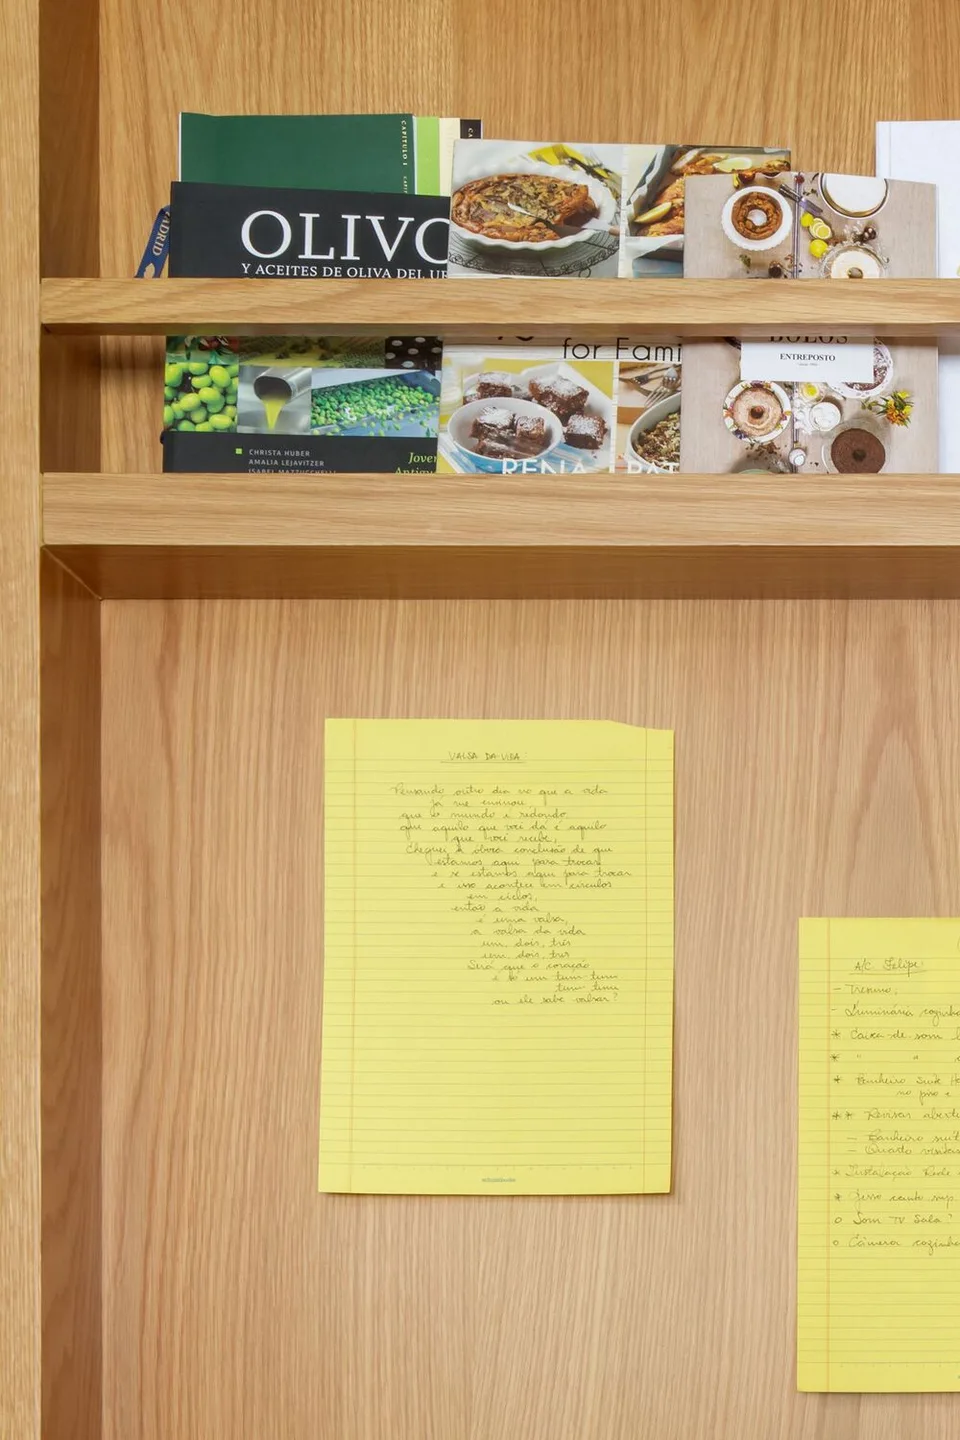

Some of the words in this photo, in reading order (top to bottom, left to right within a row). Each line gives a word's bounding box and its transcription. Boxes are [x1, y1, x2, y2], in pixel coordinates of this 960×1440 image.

[241, 263, 251, 274] Y
[255, 264, 317, 278] ACEITES
[322, 266, 343, 278] DE
[347, 267, 392, 279] OLIVA
[563, 337, 601, 360] for
[616, 337, 682, 362] Fami
[779, 353, 836, 362] ENTREPOSTO
[248, 448, 282, 457] CHRISTA
[284, 449, 311, 458] HUBER
[248, 458, 279, 467] AMALIA
[281, 459, 325, 468] LEJAVITZER
